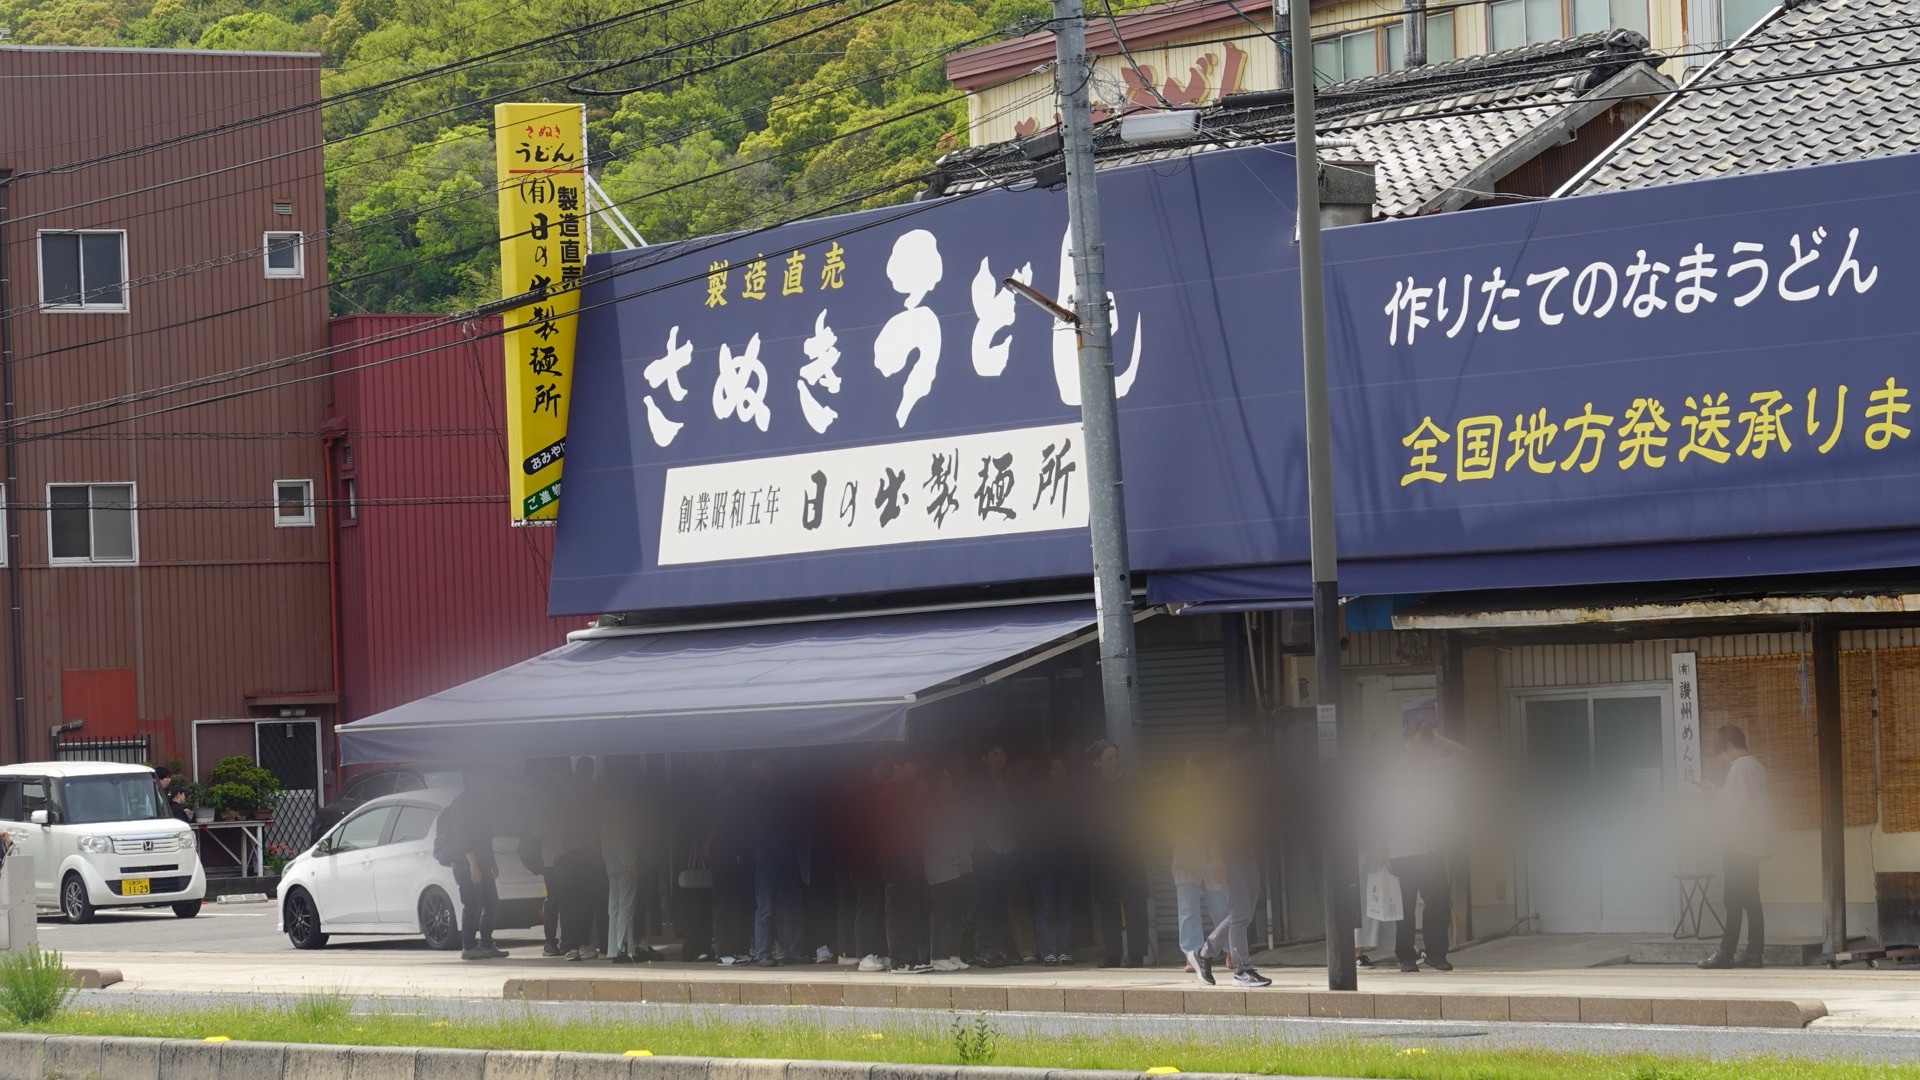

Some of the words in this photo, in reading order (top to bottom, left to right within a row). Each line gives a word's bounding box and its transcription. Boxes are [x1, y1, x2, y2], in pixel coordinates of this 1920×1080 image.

[516, 143, 574, 163] うどん
[525, 125, 561, 139] さぬき
[558, 186, 582, 290] 製造直売
[704, 241, 846, 309] 製造直売
[1384, 226, 1878, 346] 作りたてのなまうどん
[1400, 377, 1912, 486] 全国地方発送承りま
[678, 485, 781, 534] 創業昭和五年
[802, 438, 1078, 530] 日の出製麺所
[129, 885, 149, 894] 11-29
